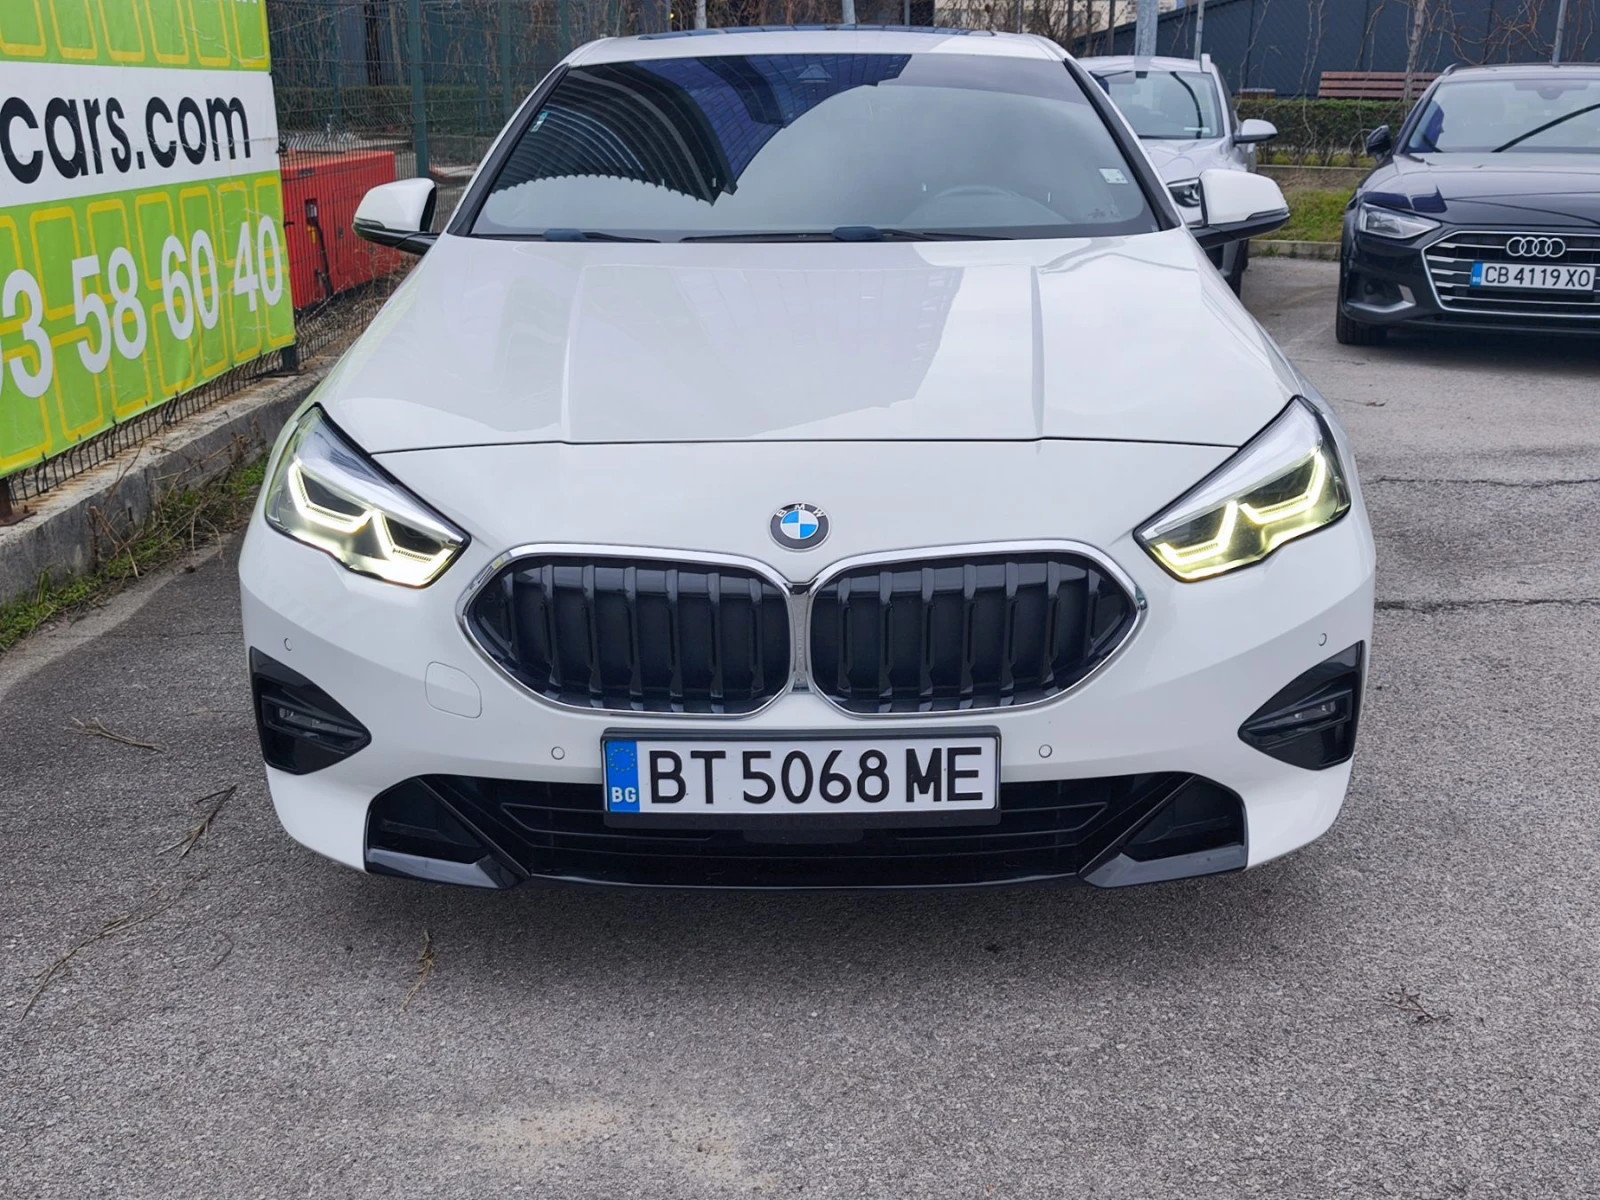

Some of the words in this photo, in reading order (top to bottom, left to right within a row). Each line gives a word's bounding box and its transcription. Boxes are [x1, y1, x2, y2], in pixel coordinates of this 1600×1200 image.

[0, 96, 251, 185] cars.com
[1485, 265, 1510, 284] CB
[1514, 267, 1561, 287] 4119
[1564, 269, 1591, 287] XO
[0, 268, 54, 398] 3
[71, 246, 148, 374] 58
[161, 229, 220, 341] 60
[233, 215, 283, 312] 40
[775, 503, 826, 518] BMW
[611, 786, 637, 803] BG
[649, 749, 726, 804] BT
[742, 749, 890, 804] 5068
[905, 746, 983, 802] ME
